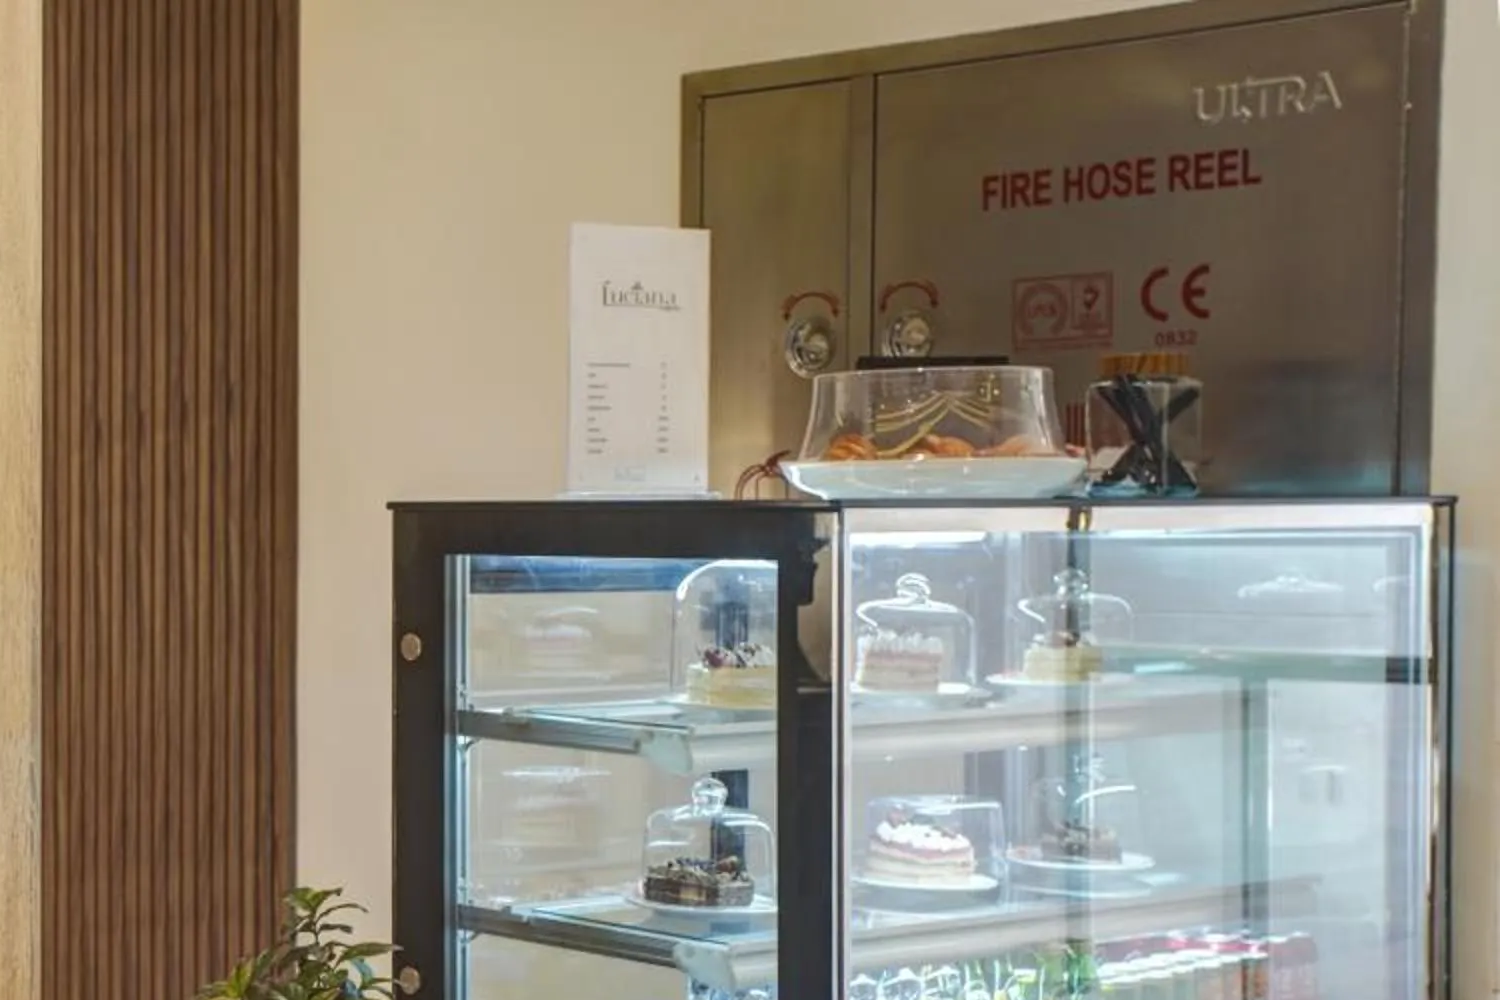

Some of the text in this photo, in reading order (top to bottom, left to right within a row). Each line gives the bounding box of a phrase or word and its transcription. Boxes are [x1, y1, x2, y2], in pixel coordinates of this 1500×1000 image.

[1194, 72, 1342, 124] ULTRA
[982, 148, 1263, 211] FIRE HOSE REEL
[1141, 264, 1211, 322] CE
